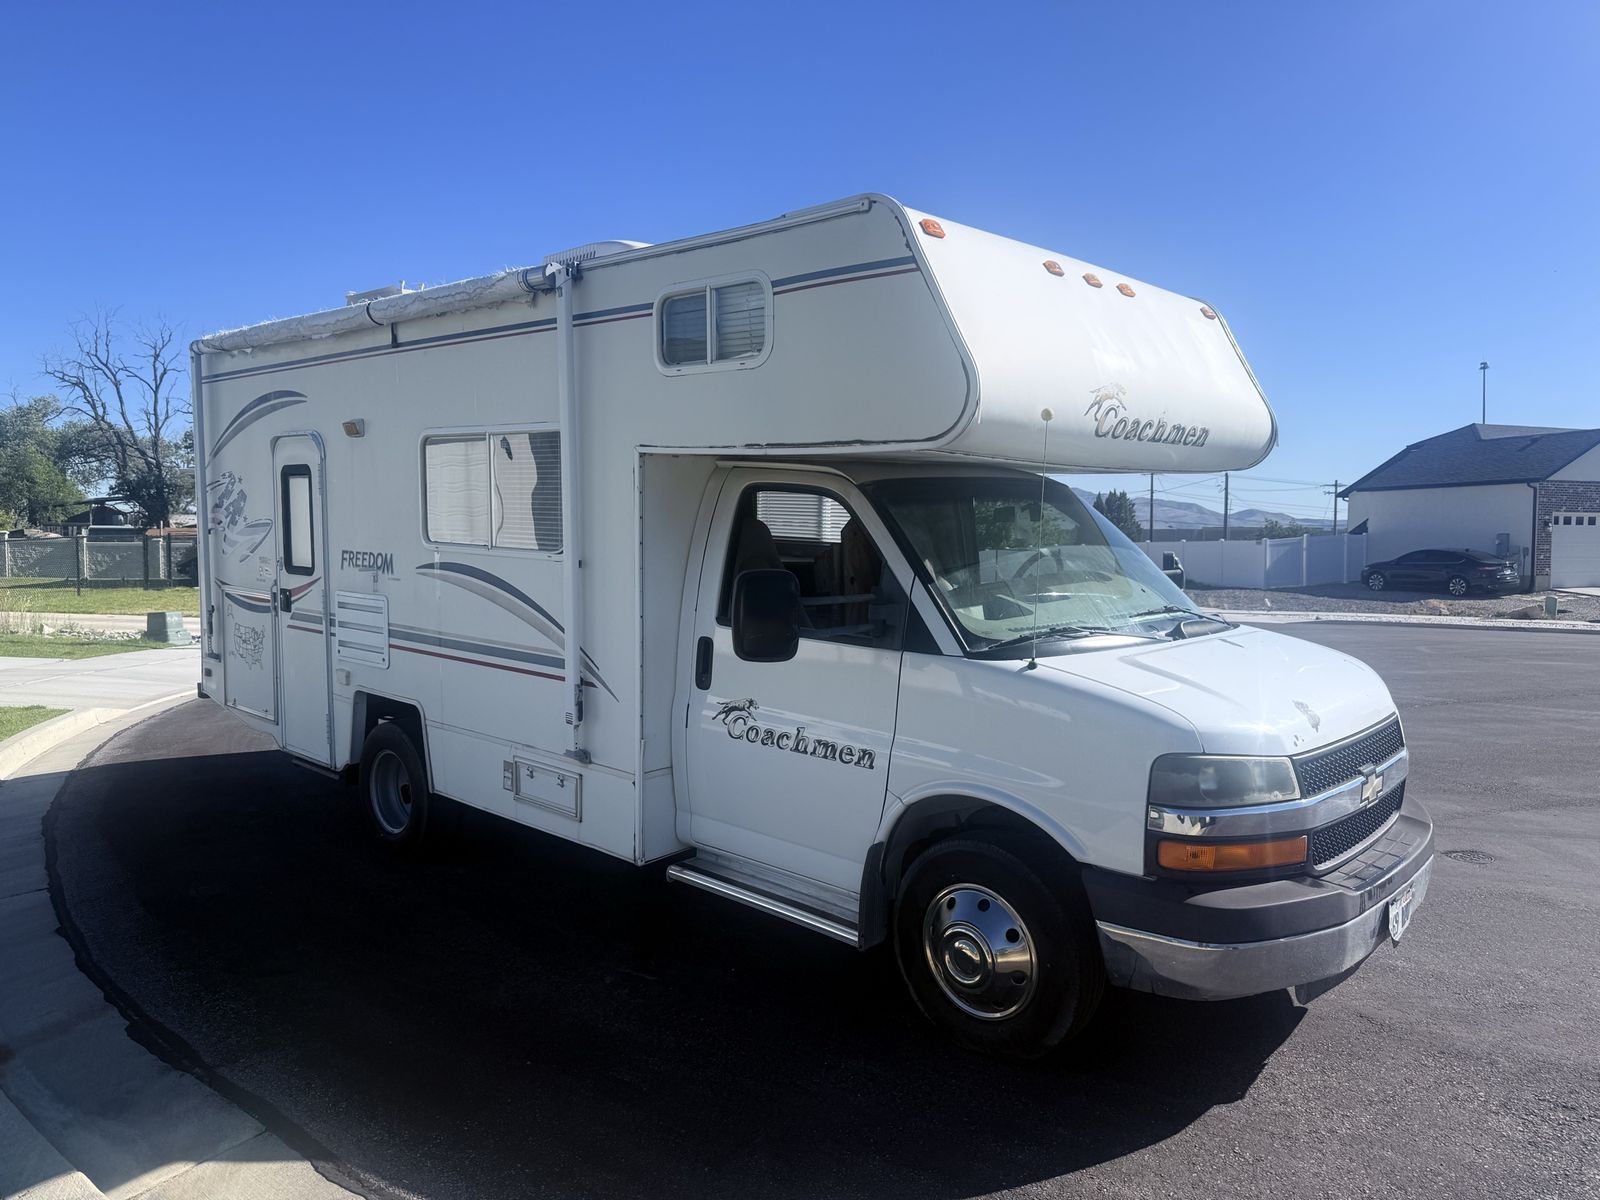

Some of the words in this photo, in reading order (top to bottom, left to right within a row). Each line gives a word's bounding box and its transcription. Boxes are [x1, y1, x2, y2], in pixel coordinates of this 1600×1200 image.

[1094, 404, 1210, 448] Coachmen
[340, 549, 394, 575] FREEDOM
[727, 713, 877, 770] Coachmen
